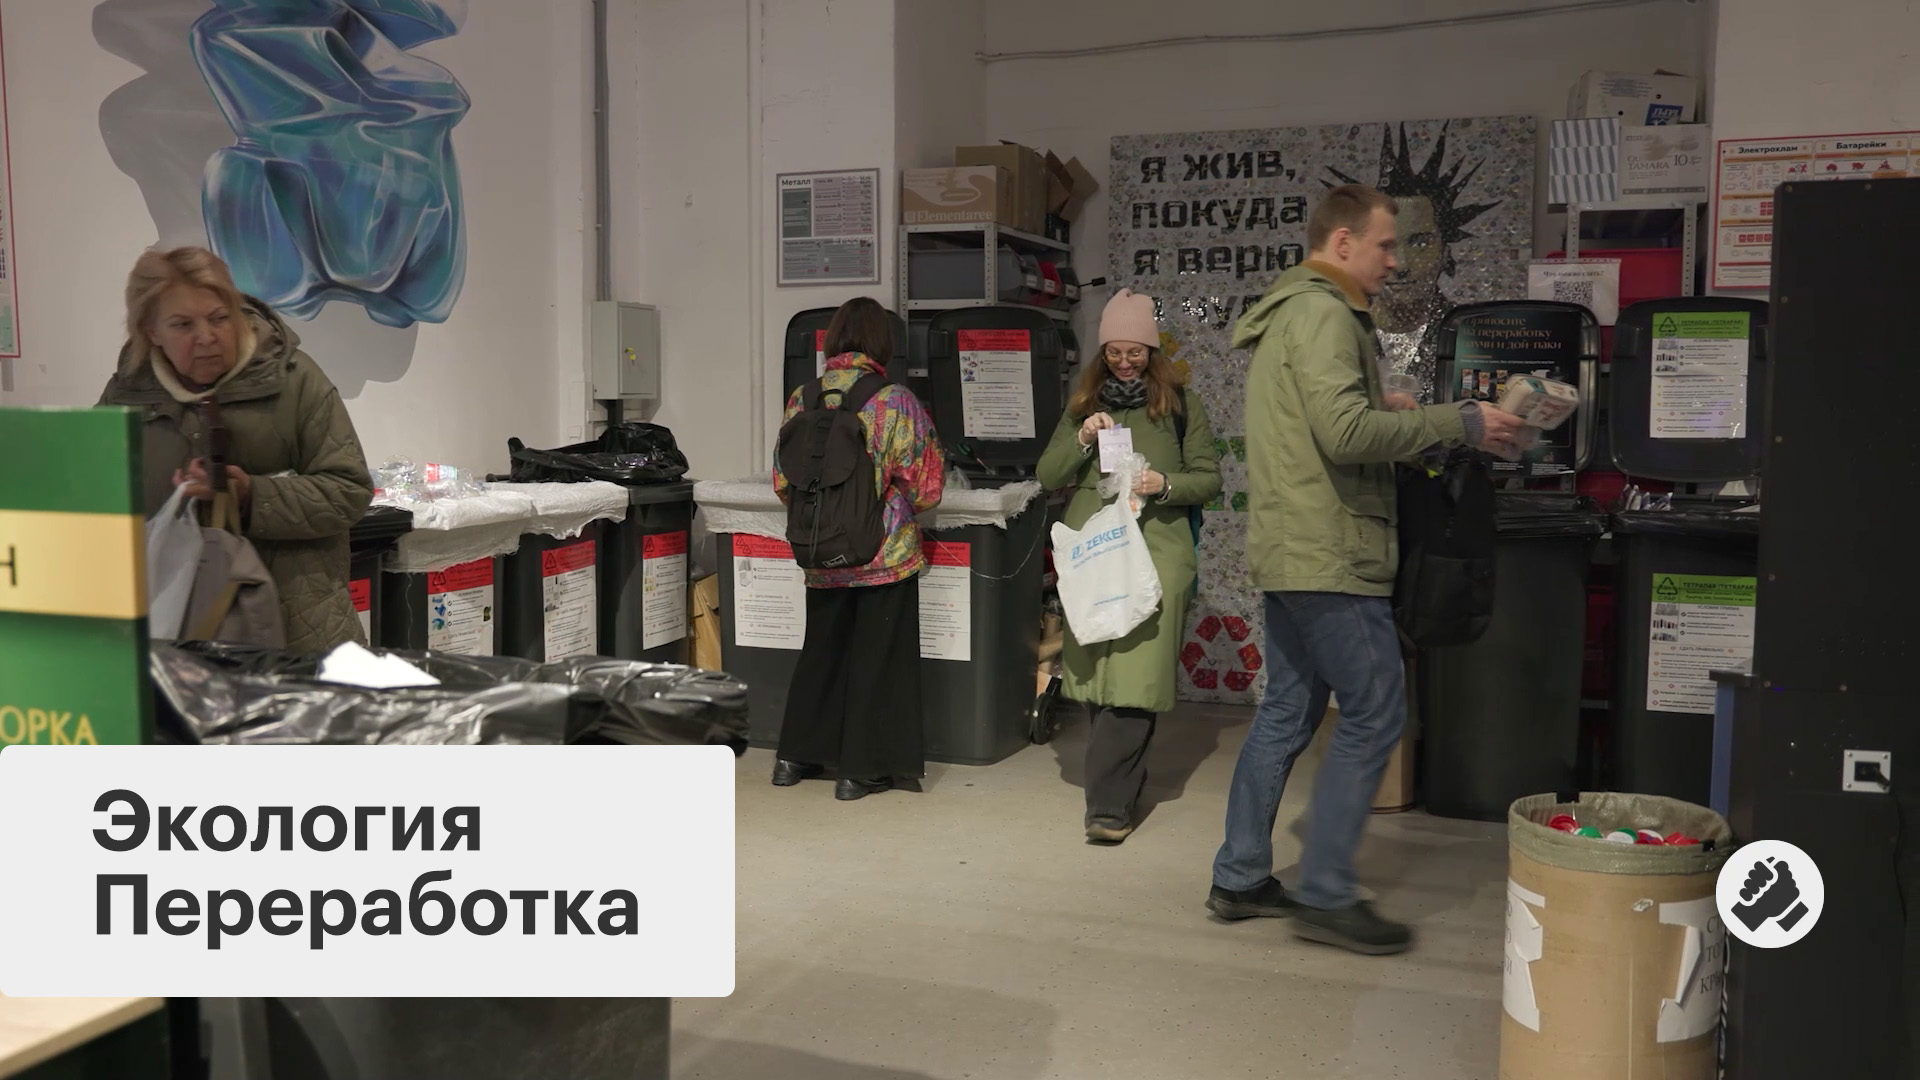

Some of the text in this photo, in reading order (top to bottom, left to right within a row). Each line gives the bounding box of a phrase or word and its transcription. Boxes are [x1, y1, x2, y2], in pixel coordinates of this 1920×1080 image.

[1738, 145, 1798, 155] Электрохлам
[1836, 141, 1887, 150] Батарейки
[1141, 150, 1295, 183] я жив,
[917, 210, 993, 222] Elementaree
[1132, 196, 1307, 234] покуда
[1134, 243, 1304, 279] я верю
[1478, 326, 1552, 340] переработку
